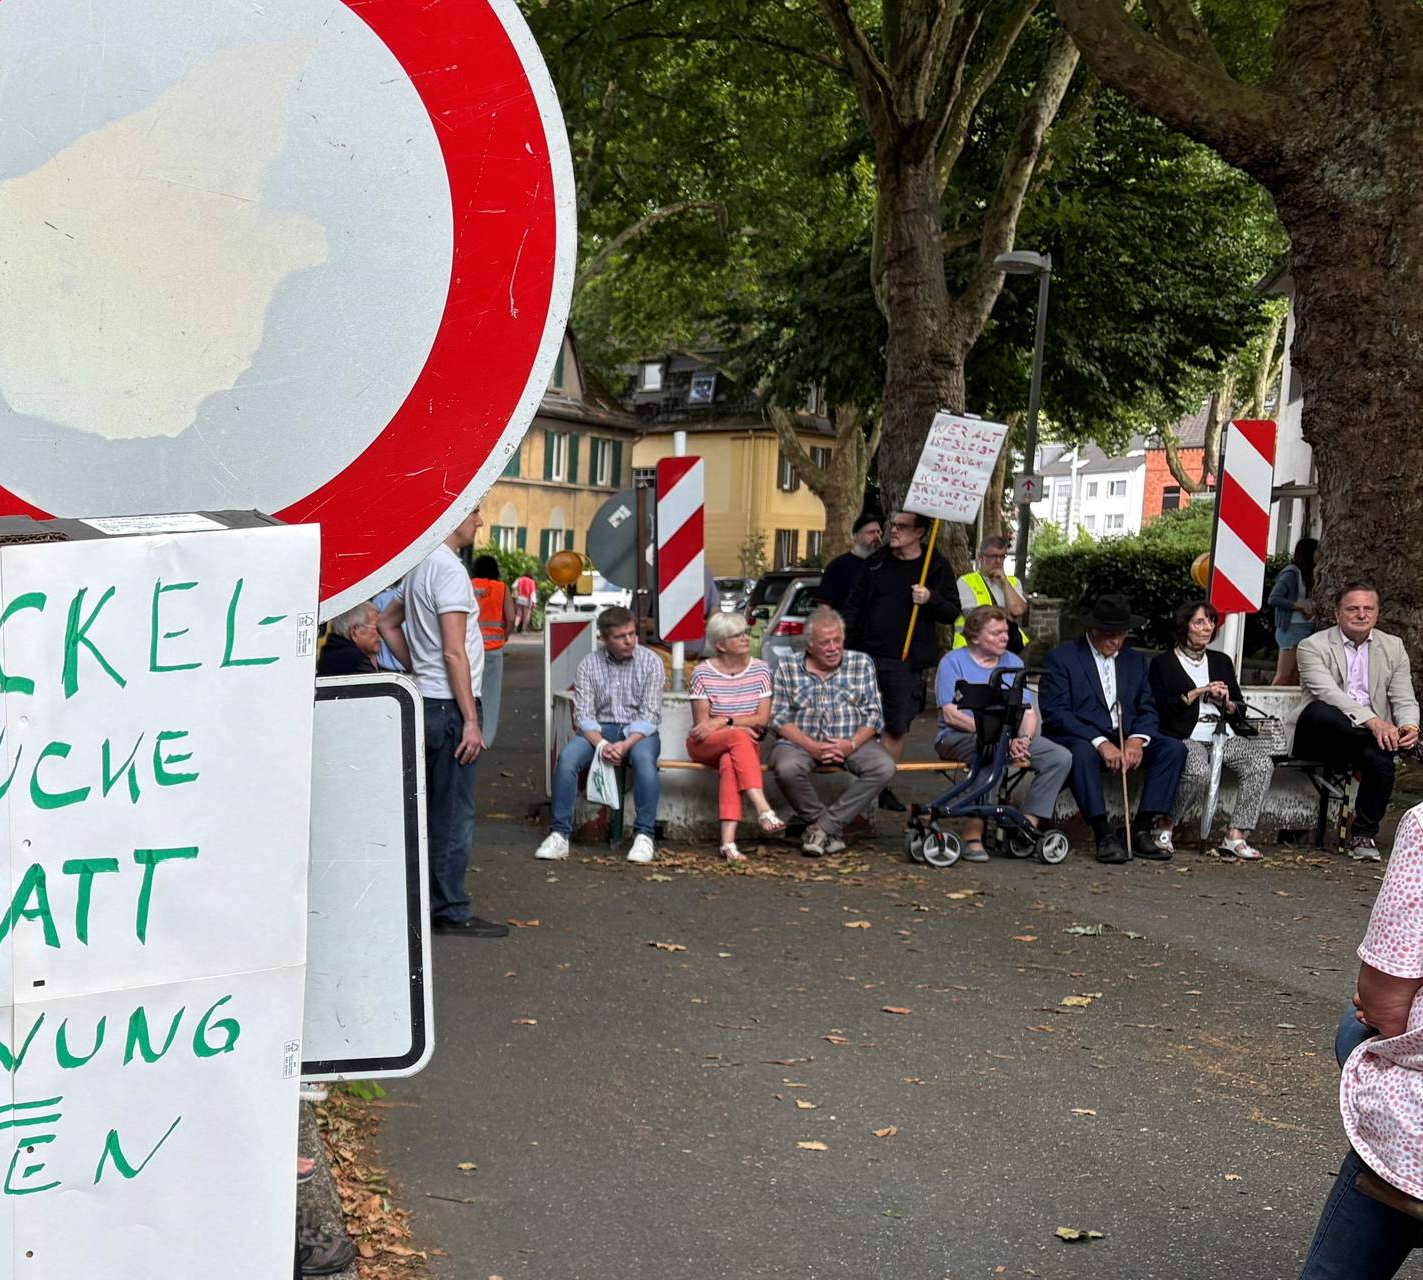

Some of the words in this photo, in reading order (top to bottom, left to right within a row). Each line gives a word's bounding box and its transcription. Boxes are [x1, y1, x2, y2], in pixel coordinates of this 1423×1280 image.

[933, 421, 968, 438] WER
[971, 429, 1003, 443] ALT
[930, 435, 952, 448] IST
